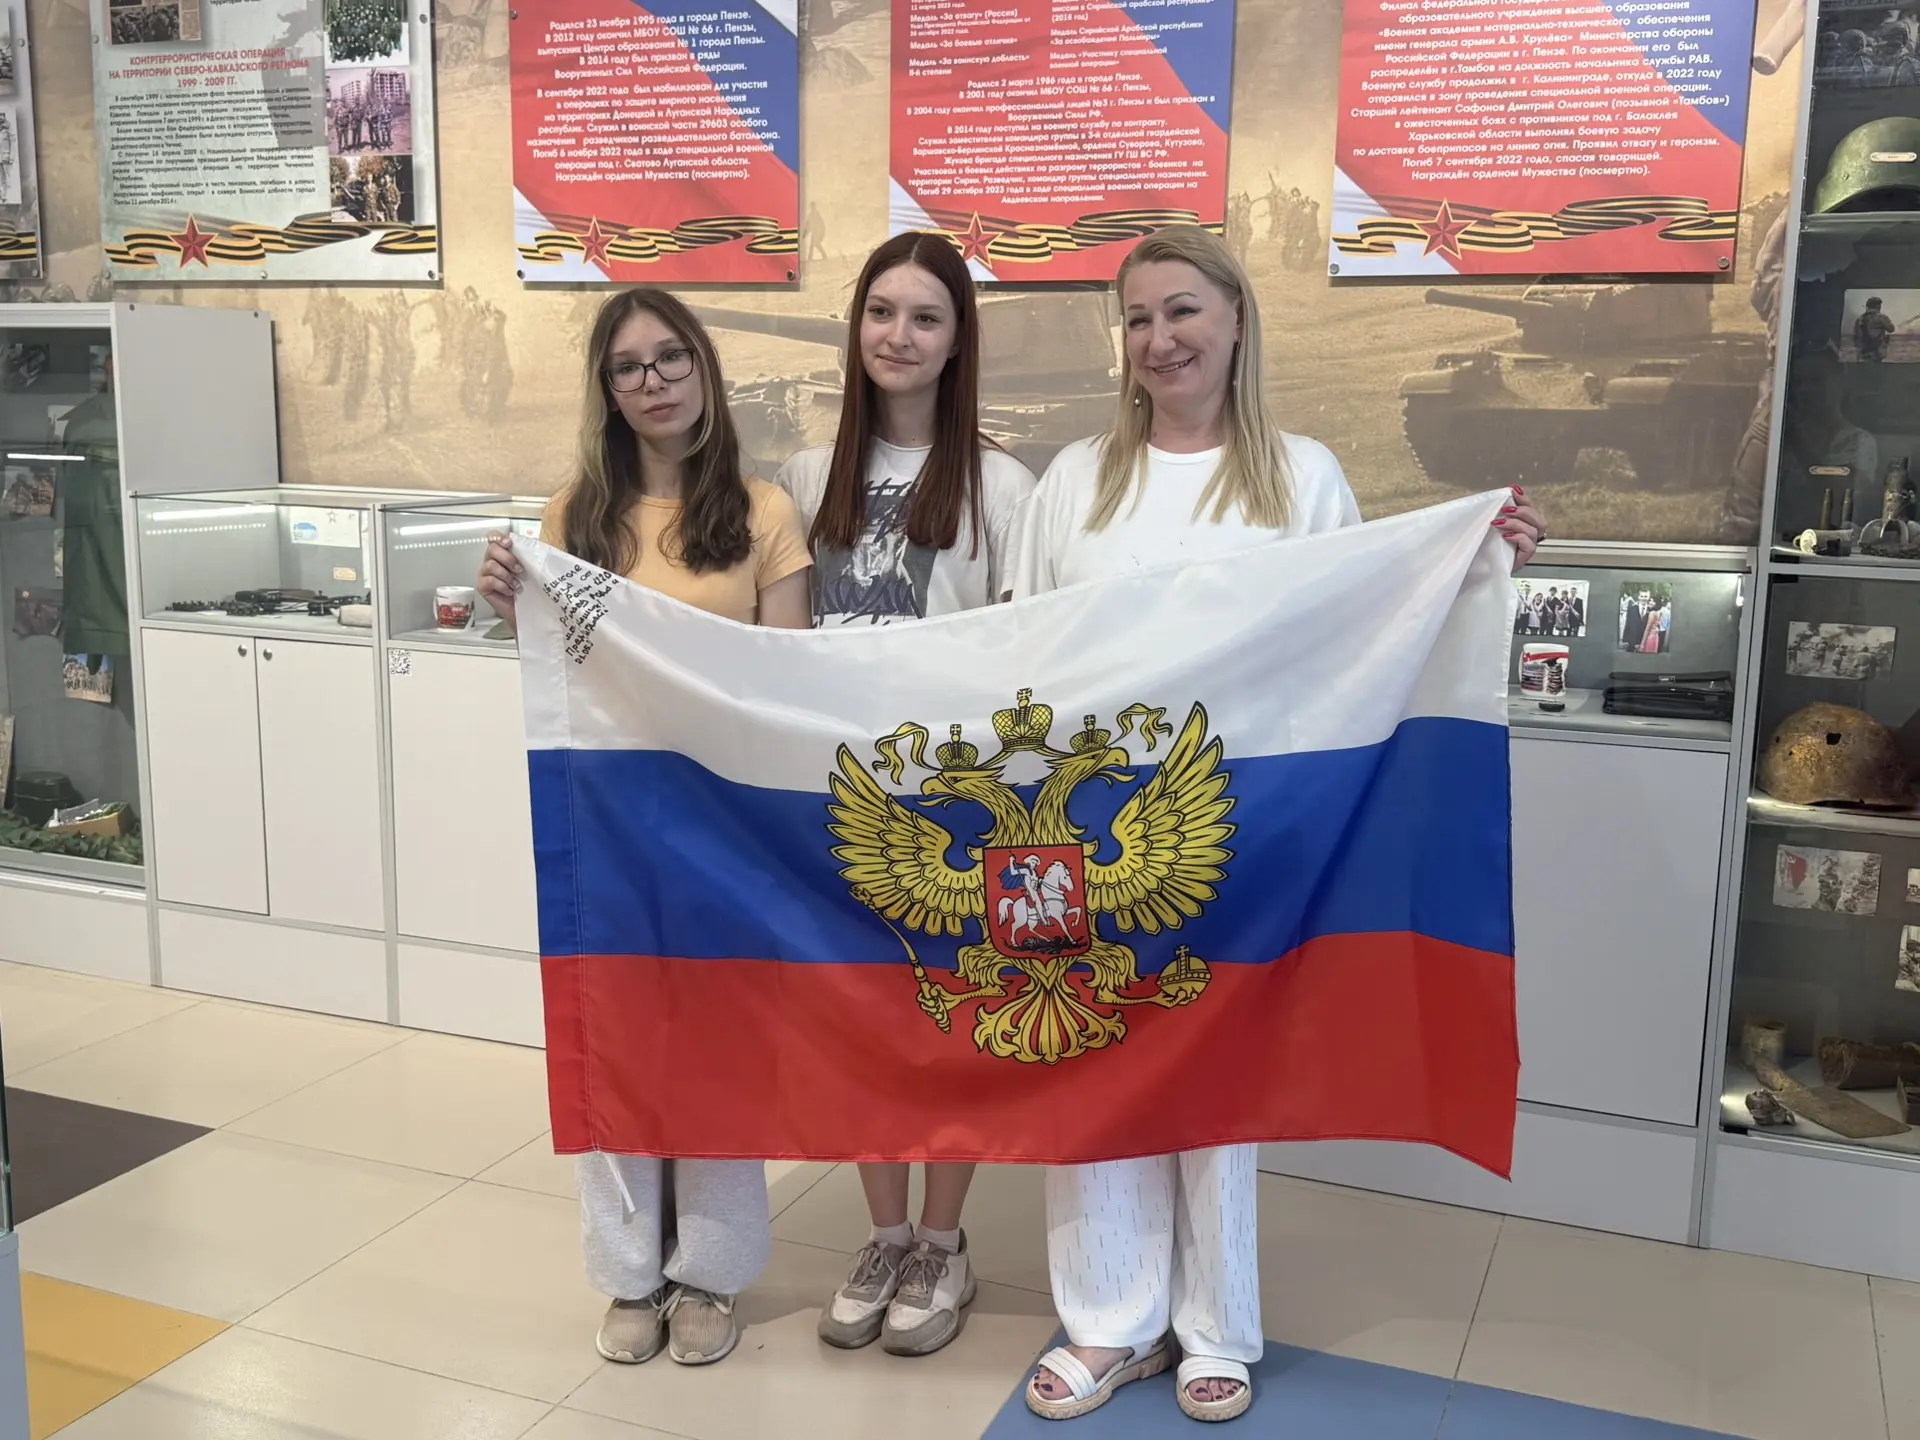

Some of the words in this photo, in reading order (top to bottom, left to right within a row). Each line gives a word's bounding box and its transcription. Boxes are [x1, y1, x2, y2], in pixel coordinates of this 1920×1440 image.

[1380, 1, 1419, 11] Филиал
[1399, 11, 1495, 25] образовательного
[1498, 8, 1562, 21] учреждения
[1565, 6, 1613, 15] высшего
[1616, 2, 1690, 14] образования
[550, 22, 584, 31] Родился
[586, 19, 598, 28] 23
[599, 18, 631, 28] ноября
[634, 15, 655, 26] 1995
[656, 16, 677, 24] года
[686, 14, 718, 24] городе
[720, 11, 751, 20] Пензе.
[1379, 28, 1427, 38] «Военная
[1430, 26, 1481, 35] академия
[1484, 18, 1631, 33] материально-технического
[1637, 15, 1711, 25] обеспечения
[537, 47, 582, 57] выпускник
[583, 44, 616, 54] Центра
[617, 42, 675, 53] образования
[677, 39, 689, 48] №
[692, 38, 696, 47] 1
[699, 38, 732, 49] города
[734, 36, 766, 45] Пензы.
[1374, 43, 1407, 51] имени
[1409, 40, 1458, 50] генерала
[1461, 39, 1496, 48] армии
[1498, 35, 1518, 45] А.В.
[1523, 34, 1573, 46] Хрулёва»
[1580, 31, 1660, 41] Министерства
[1662, 28, 1714, 39] обороны
[130, 51, 238, 65] КОНТРТЕРРОРИСТИЧЕСКАЯ
[240, 48, 286, 59] ОПЕРАЦИЯ
[1385, 53, 1447, 63] Российской
[1450, 52, 1510, 62] Федерации
[1522, 50, 1530, 58] г.
[1533, 48, 1568, 57] Пензе.
[1572, 46, 1587, 55] По
[1590, 45, 1649, 54] окончании
[1652, 44, 1671, 52] его
[1677, 41, 1699, 51] был
[109, 71, 121, 79] НА
[122, 68, 171, 79] ТЕРРИТОРИИ
[173, 62, 268, 75] СЕВЕРО-КАВКАЗСКОГО
[269, 60, 310, 70] РЕГИОНА
[555, 70, 613, 80] Вооруженных
[615, 67, 633, 76] Сил
[638, 64, 691, 75] Российской
[692, 63, 747, 74] Федерации.
[178, 79, 197, 88] 1999
[205, 77, 225, 87] 2009
[557, 113, 611, 123] территориях
[612, 109, 656, 121] Донецкой
[665, 108, 712, 119] Луганской
[714, 107, 760, 117] Народных
[1351, 108, 1397, 118] Старший
[1400, 107, 1452, 116] лейтенант
[1455, 103, 1505, 115] Сафонов
[1507, 101, 1555, 113] Дмитрий
[1557, 100, 1608, 109] Олегович
[1611, 97, 1670, 110] (позывной
[1673, 95, 1730, 106] «Тамбов»)
[583, 136, 640, 147] разведчиком
[730, 131, 780, 141] батальона.
[1408, 131, 1476, 142] Харьковской
[1478, 129, 1522, 139] области
[1525, 129, 1575, 137] выполнял
[1578, 126, 1620, 137] боевую
[1623, 127, 1661, 135] задачу
[554, 162, 596, 171] операции
[624, 159, 661, 168] Сватово
[663, 158, 710, 169] Луганской
[711, 157, 750, 166] области.
[1403, 158, 1433, 167] Погиб
[1436, 157, 1442, 166] 7
[1445, 156, 1493, 167] сентября
[1496, 155, 1522, 165] 2022
[1526, 156, 1552, 165] года,
[1556, 155, 1596, 163] спасая
[1599, 152, 1662, 163] товарищей.
[556, 173, 603, 183] Награждён
[604, 173, 643, 183] орденом
[645, 171, 690, 181] Мужества
[1412, 170, 1470, 181] Награждён
[1472, 170, 1519, 180] орденом
[1522, 168, 1576, 179] Мужества
[1579, 165, 1650, 178] (посмертно).
